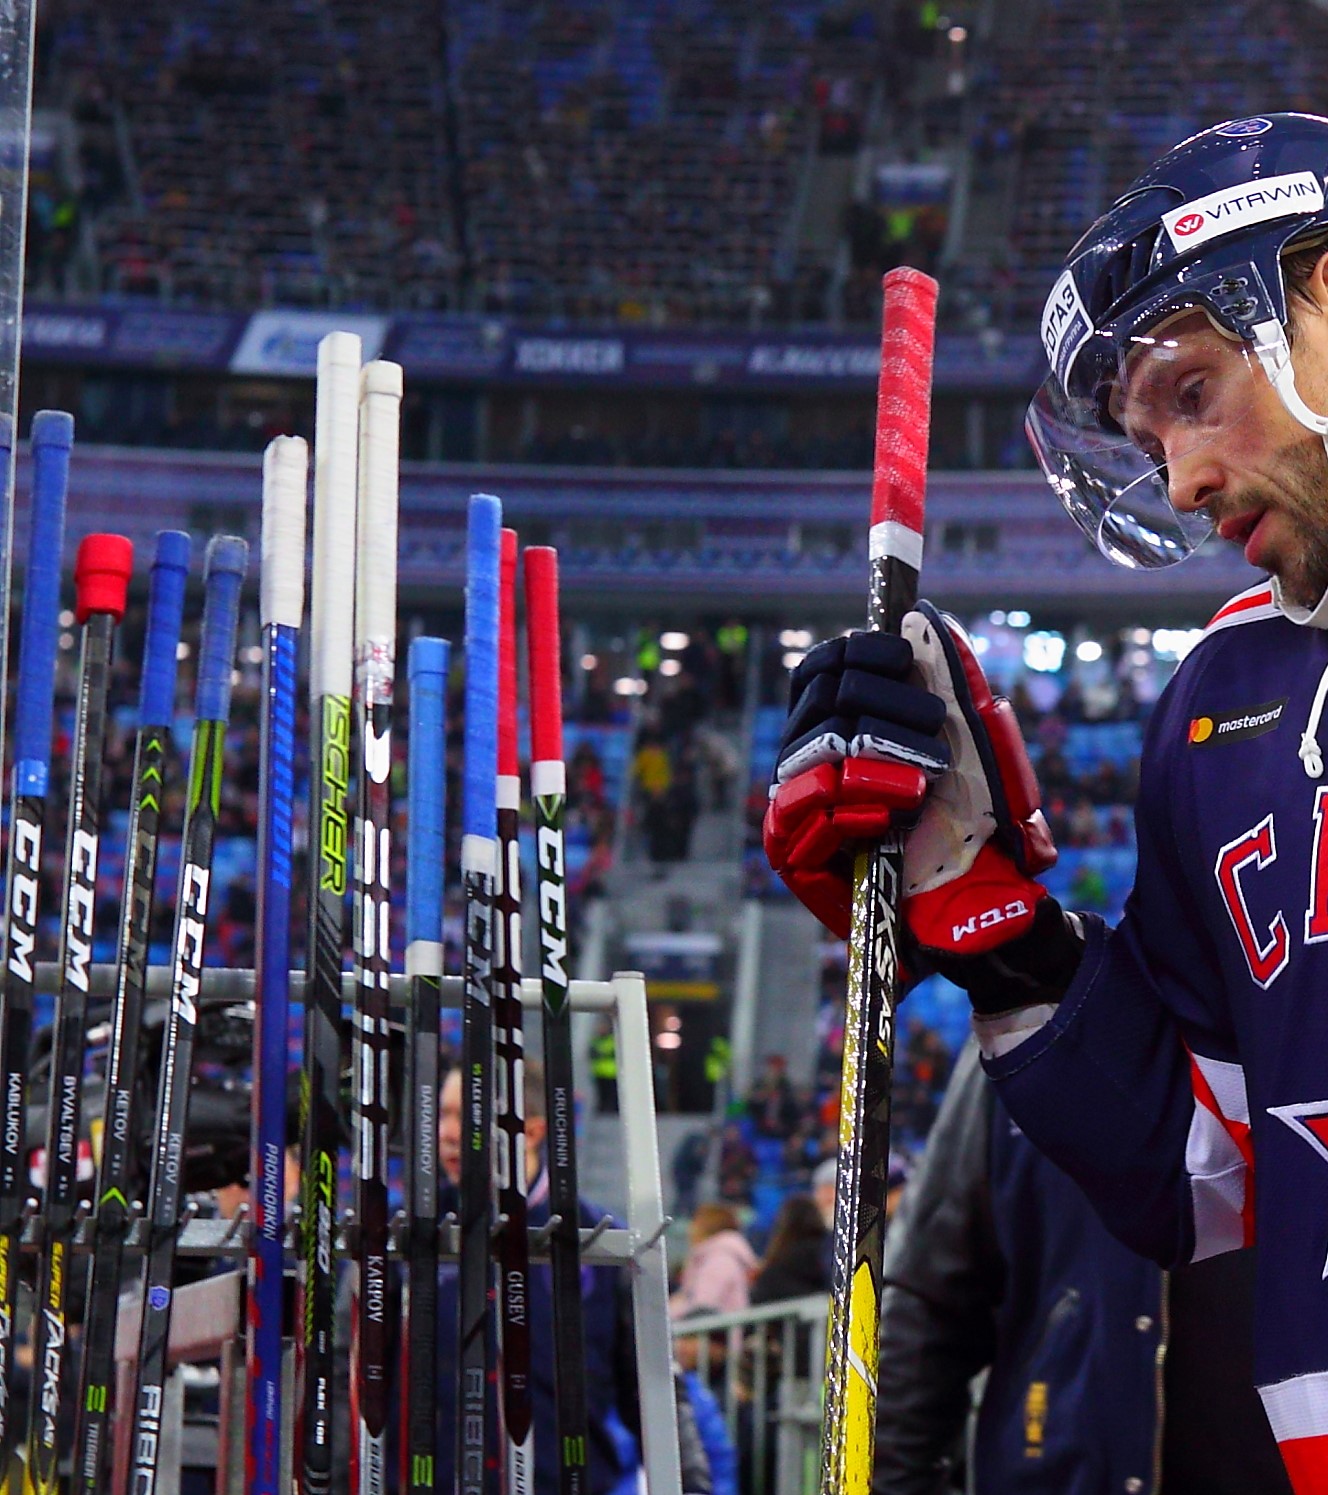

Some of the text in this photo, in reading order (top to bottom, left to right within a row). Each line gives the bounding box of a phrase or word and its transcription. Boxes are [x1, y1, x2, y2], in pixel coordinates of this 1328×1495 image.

[1205, 181, 1317, 221] VITAWIN
[1217, 704, 1283, 735] mastercard
[320, 693, 350, 897] ISCHER
[8, 818, 41, 984] CCM
[65, 828, 98, 993] CCM
[128, 830, 155, 990] CCM
[537, 825, 567, 988] CCM
[875, 834, 905, 990] ACKS
[952, 900, 1029, 942] CCM
[174, 862, 210, 1025] CCM
[5, 1072, 22, 1156] KABLUKOV
[61, 1074, 77, 1165] BYVALTSEV
[114, 1088, 130, 1143] KETOV
[472, 1077, 482, 1101] FLEX
[472, 1102, 482, 1126] GRIP
[554, 1087, 568, 1168] KRUCHININ
[168, 1132, 181, 1186] KETOV
[421, 1084, 433, 1178] BARABANOV
[263, 1141, 279, 1242] PROKHORKIN
[367, 1254, 384, 1324] KARPOV
[508, 1270, 525, 1327] GUSEV
[317, 1377, 327, 1412] FLEX
[464, 1367, 486, 1495] RIBC
[84, 1422, 100, 1479] TRIGGER
